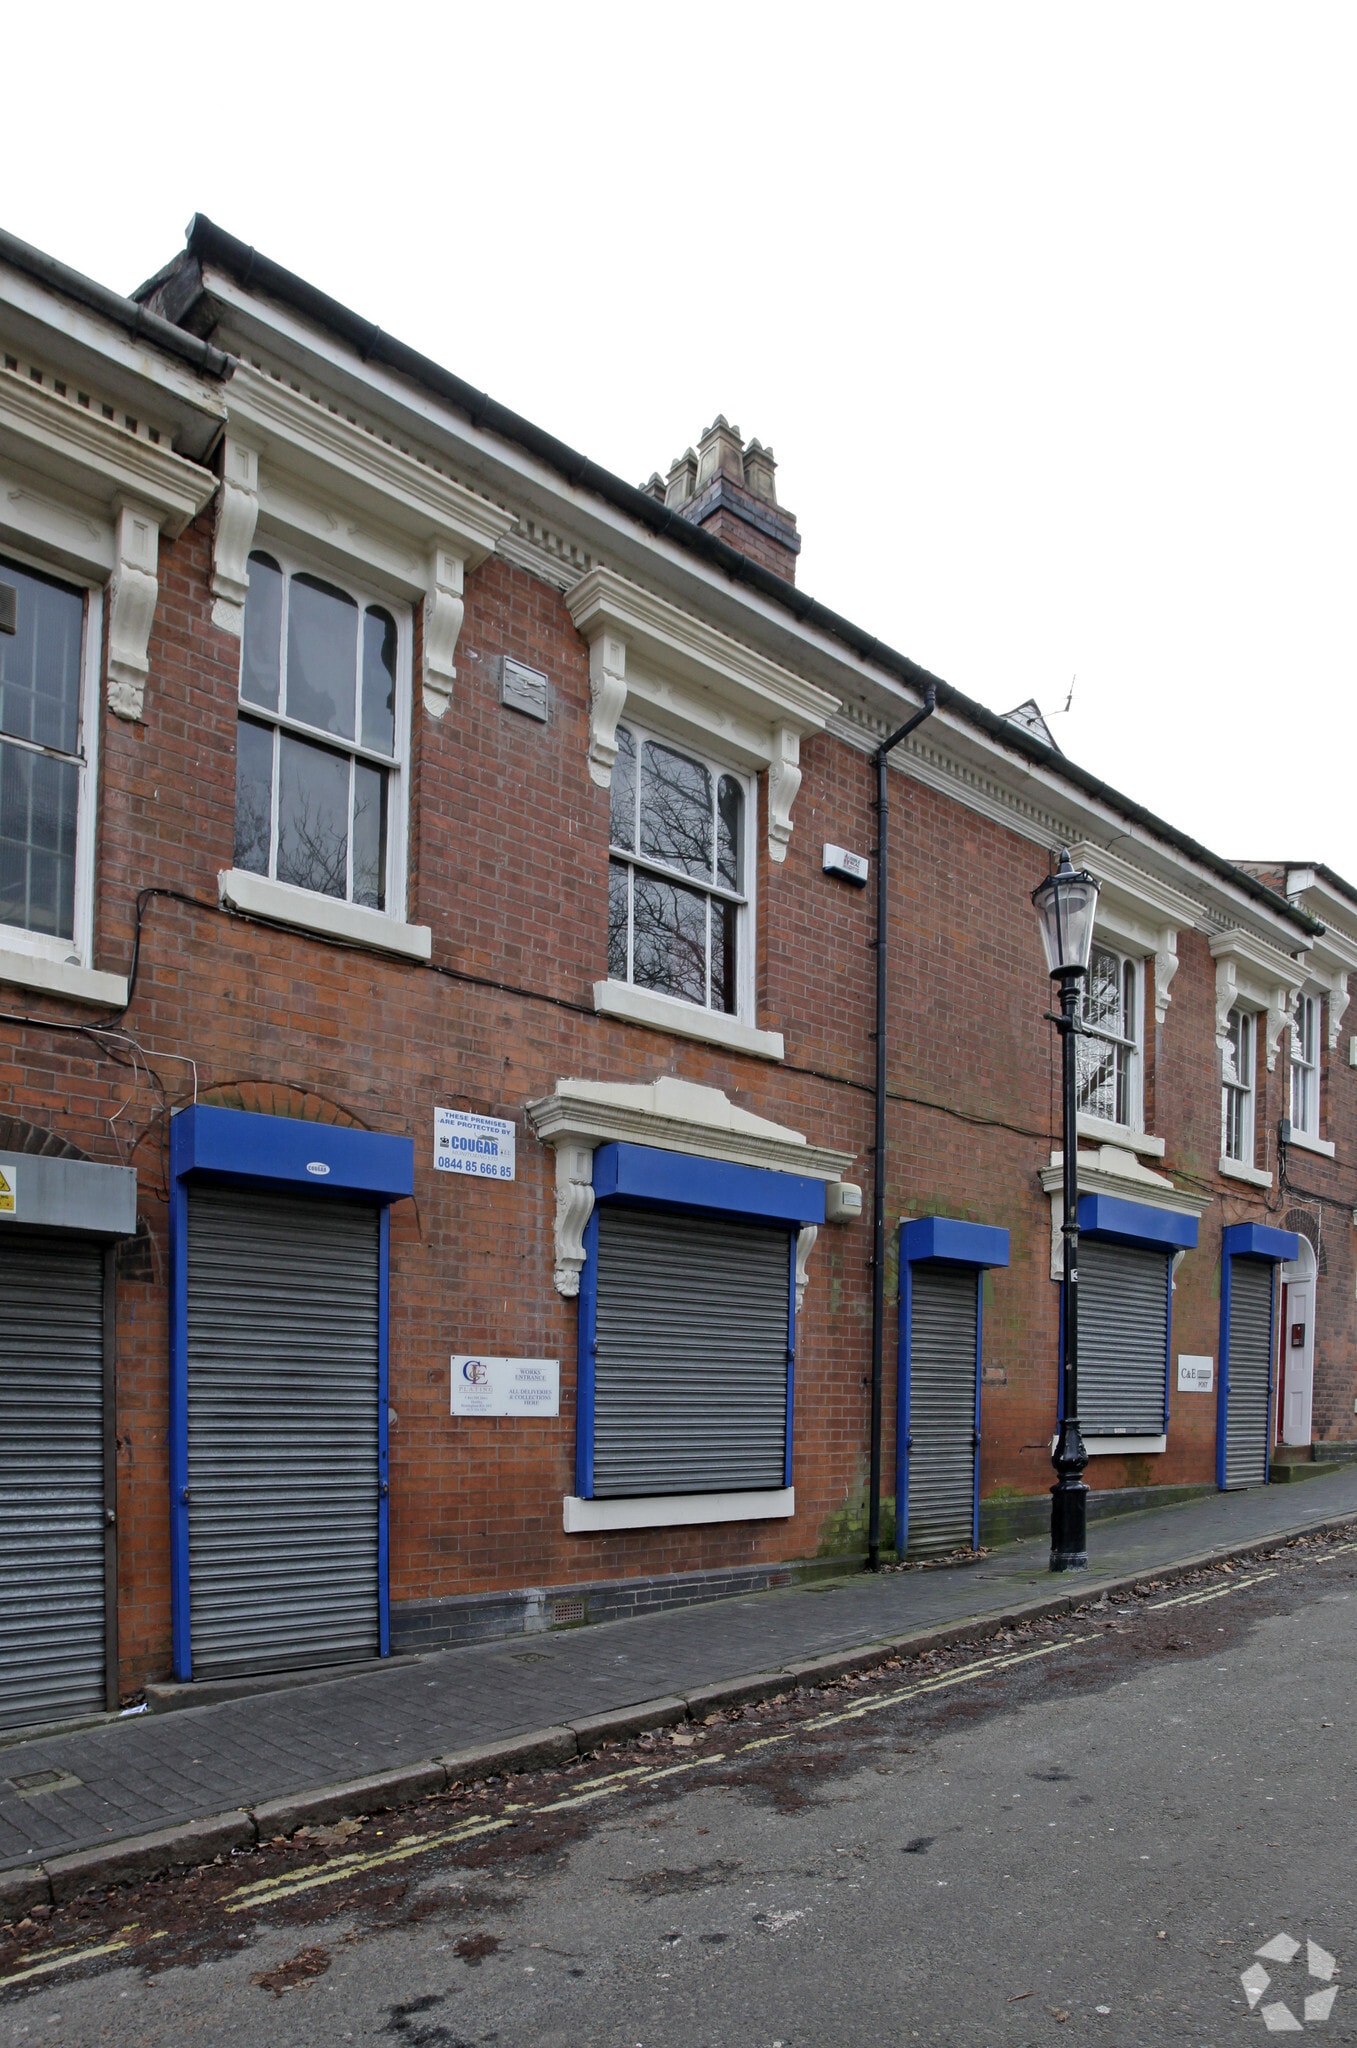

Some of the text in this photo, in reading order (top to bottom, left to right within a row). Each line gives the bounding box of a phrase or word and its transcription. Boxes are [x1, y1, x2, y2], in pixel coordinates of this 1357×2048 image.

[440, 1118, 455, 1126] ARE
[457, 1121, 500, 1133] PROTECTED
[444, 1112, 507, 1128] THESE PREMISES
[451, 1135, 498, 1156] COUGAR
[438, 1156, 512, 1178] 0844 85 666 85
